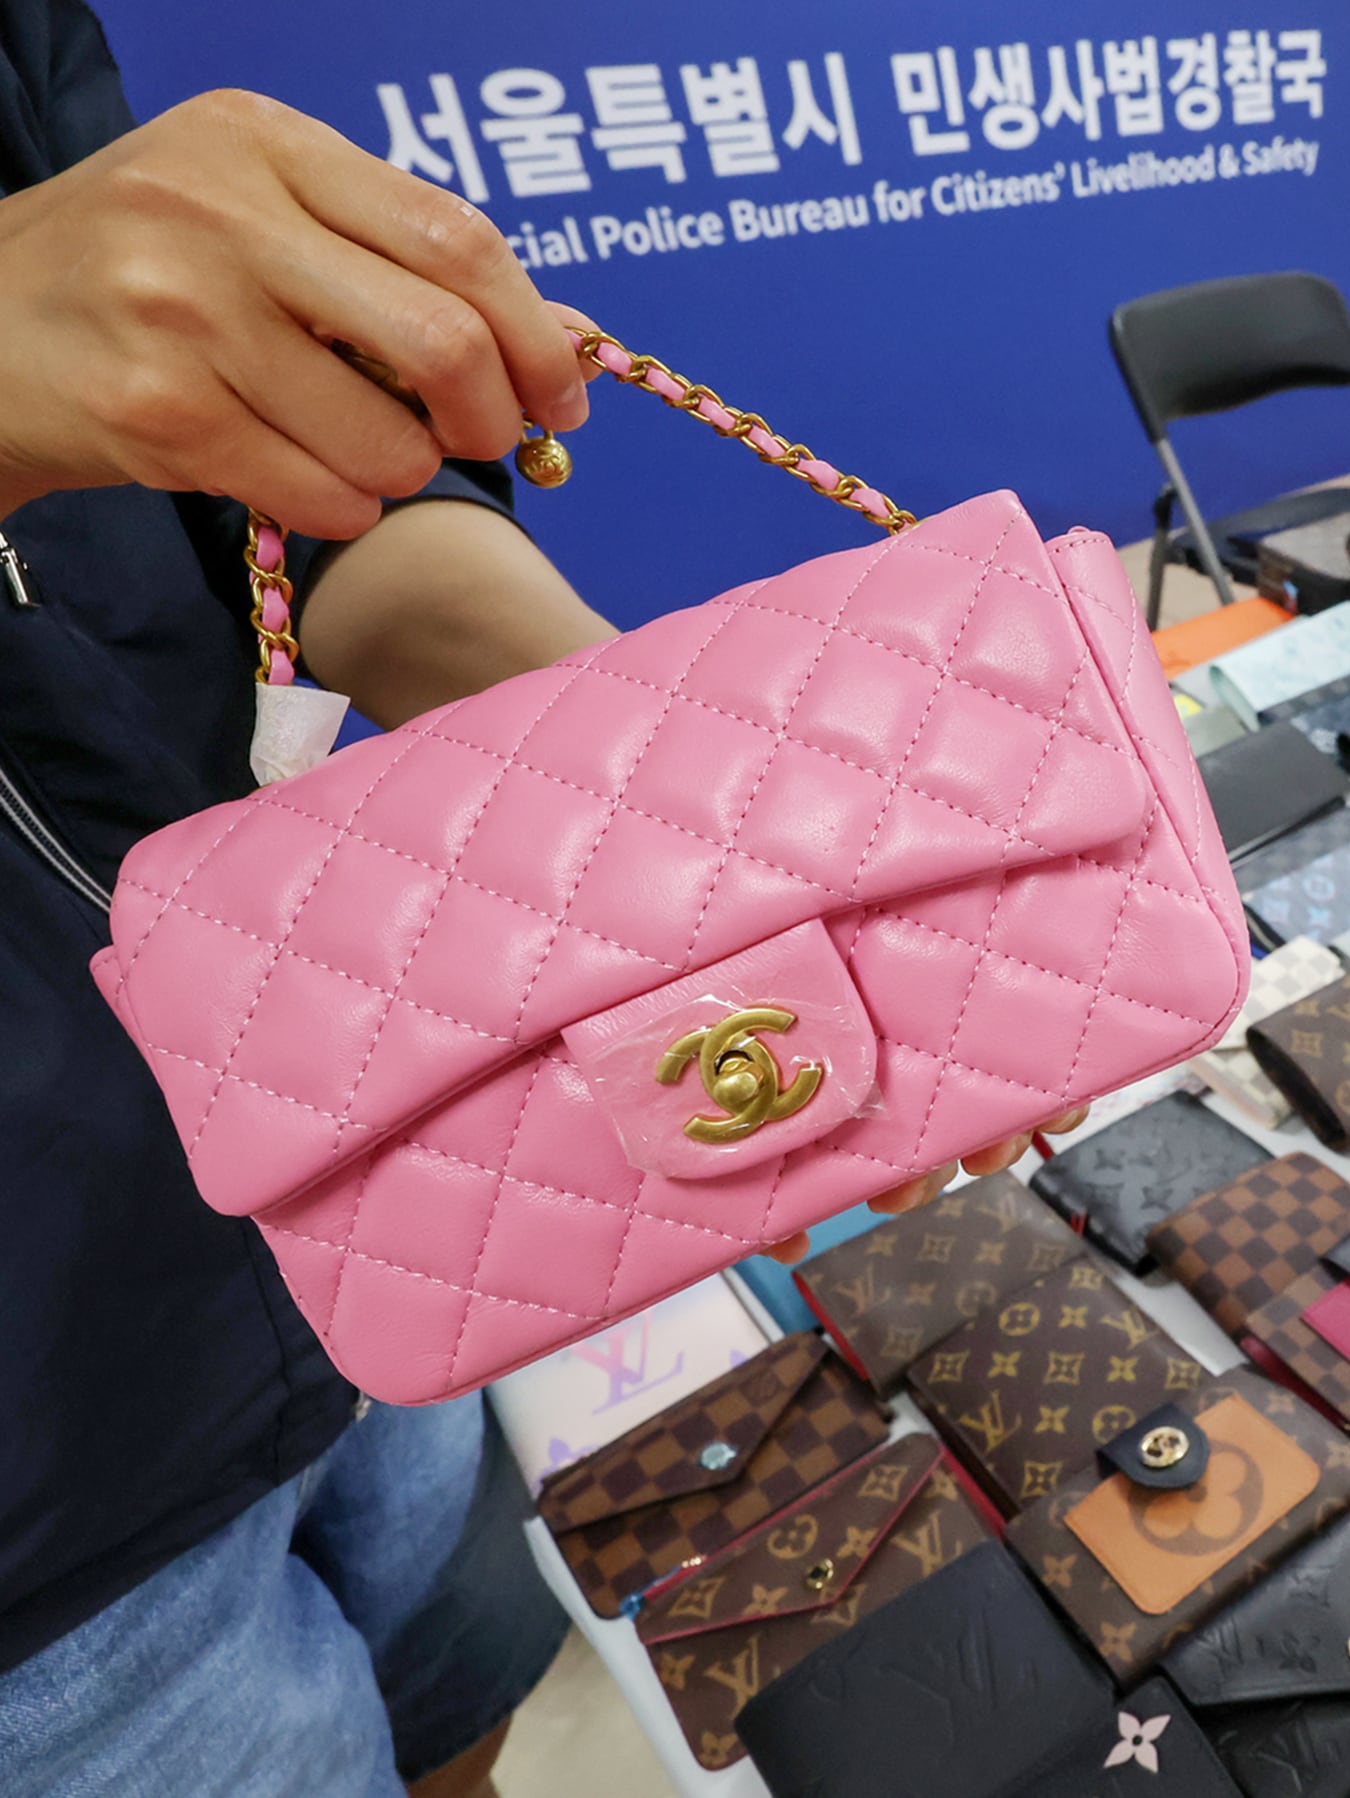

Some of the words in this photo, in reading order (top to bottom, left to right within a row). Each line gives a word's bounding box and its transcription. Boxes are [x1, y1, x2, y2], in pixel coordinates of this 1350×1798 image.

[377, 52, 863, 203] 서울특별시
[891, 29, 1327, 155] 민생사법경찰국
[590, 205, 727, 260] Police
[728, 199, 871, 242] Bureau
[873, 179, 925, 224] for
[1070, 143, 1217, 198] Livelihood
[1218, 143, 1241, 180] &
[1241, 134, 1320, 177] Safety
